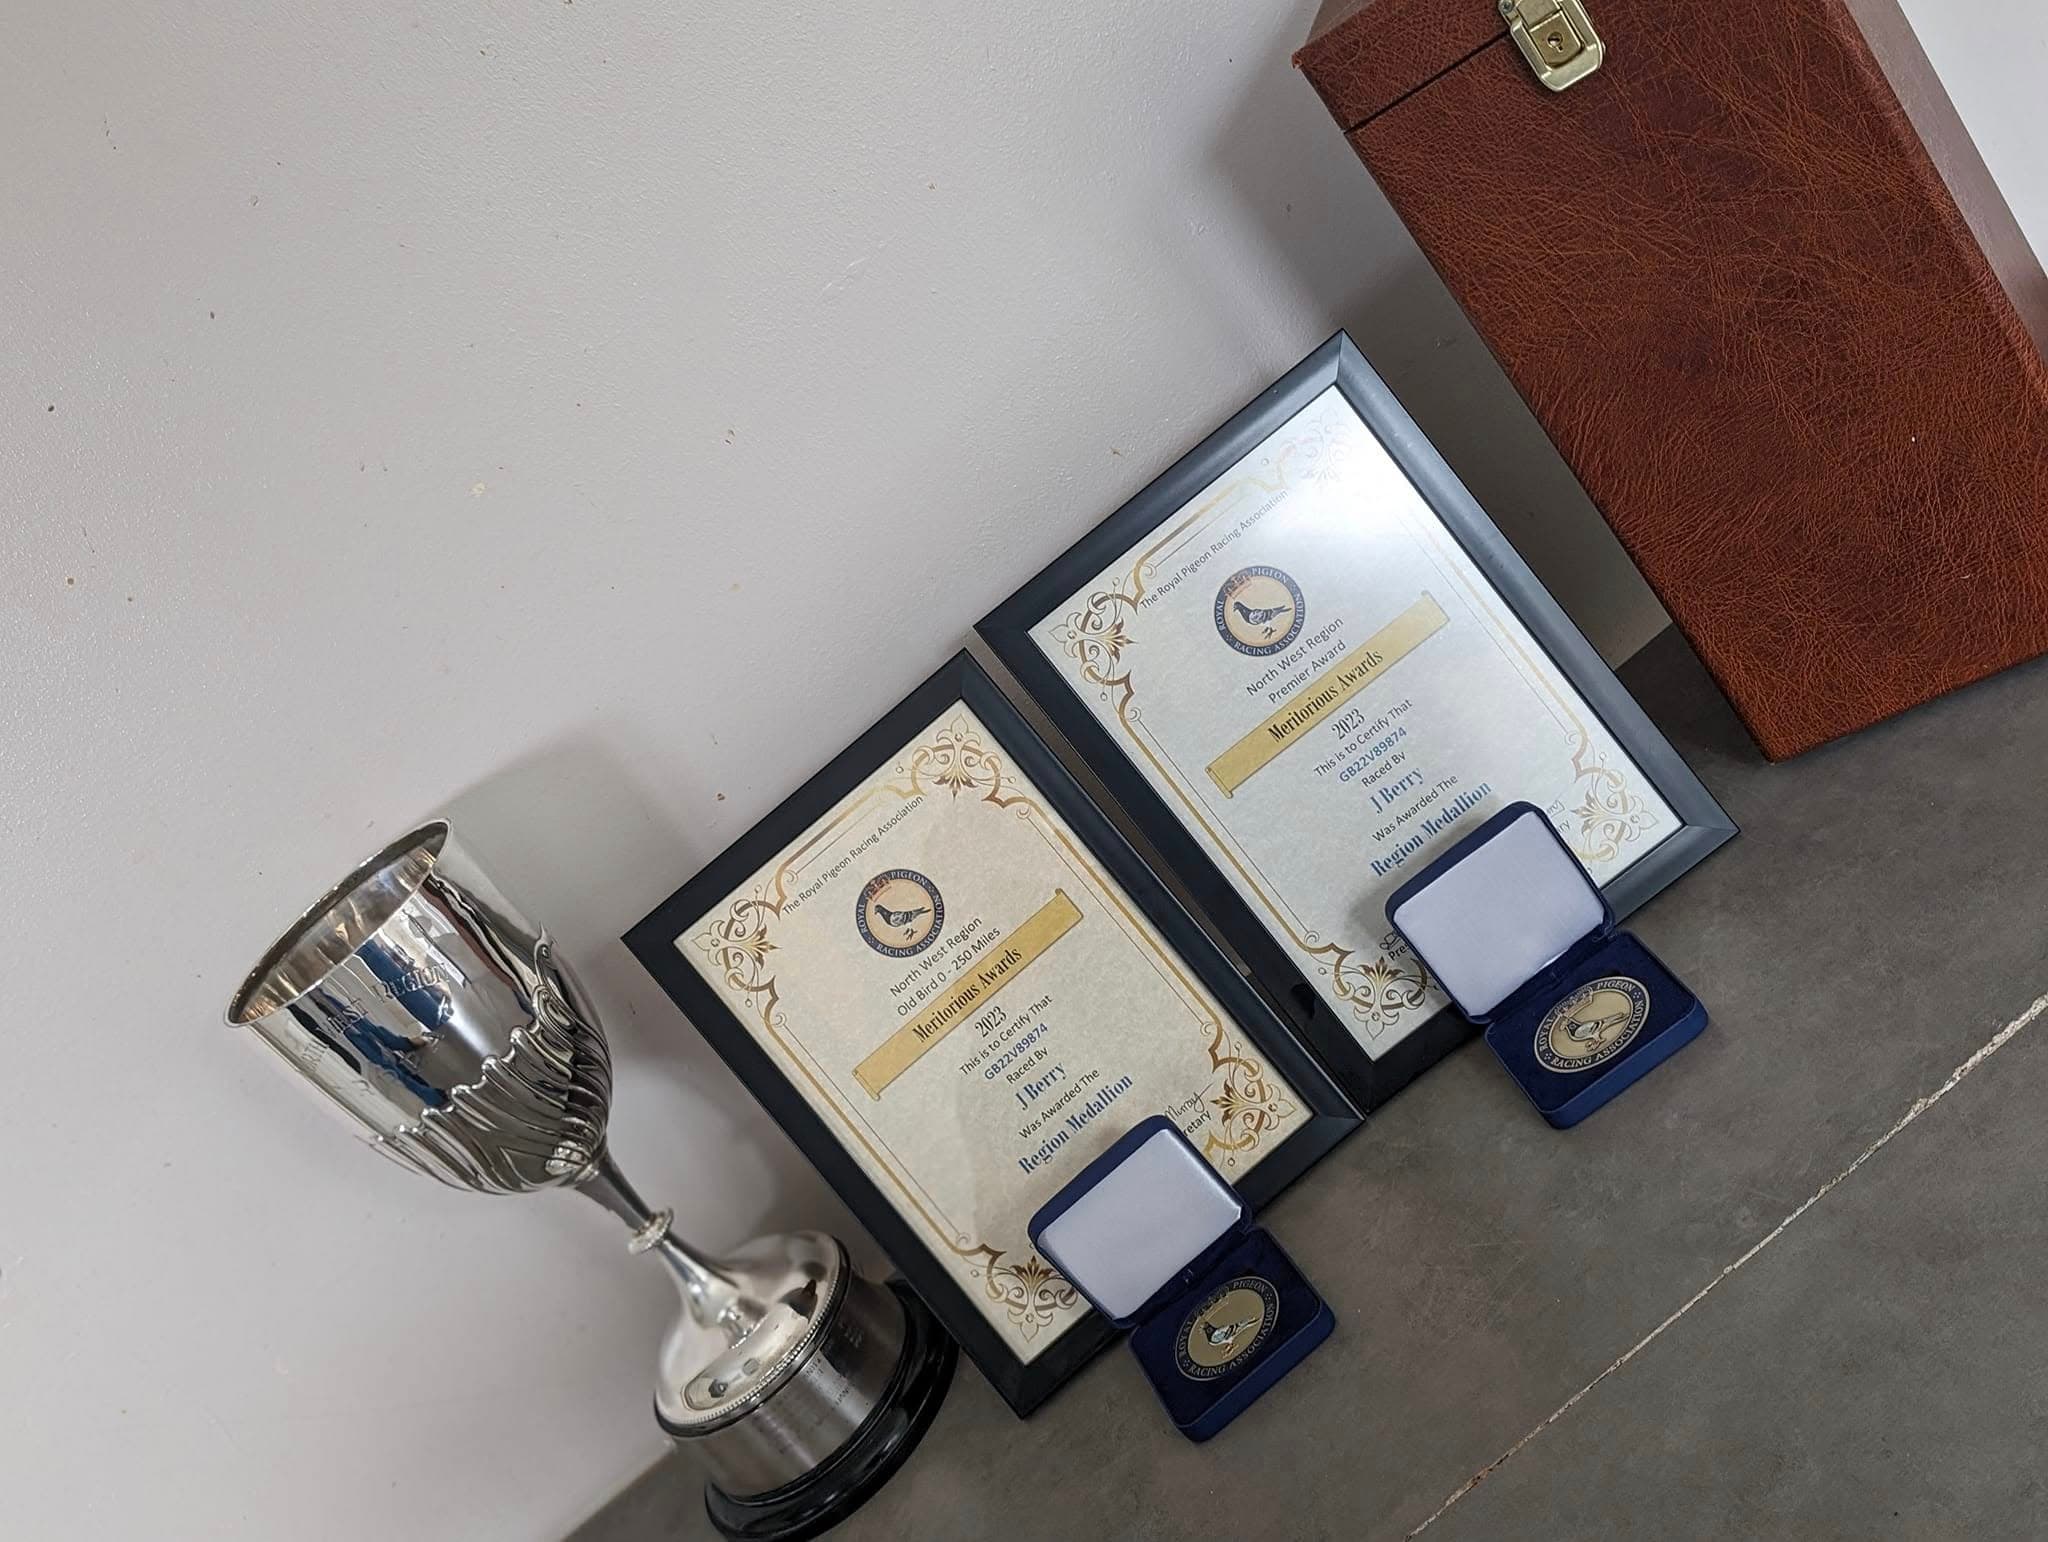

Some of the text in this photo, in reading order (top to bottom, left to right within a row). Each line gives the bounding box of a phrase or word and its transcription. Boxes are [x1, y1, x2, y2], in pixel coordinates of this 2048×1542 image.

[1140, 490, 1288, 608] The Royal Pigeon Racing Association
[1216, 568, 1288, 630] ROYAL PIGEON
[1234, 594, 1304, 655] RACING ASSOCIATION
[1246, 618, 1344, 696] North West Region
[1268, 640, 1346, 704] Premier Award
[1268, 650, 1383, 742] Meritorious Awards
[1332, 708, 1365, 740] 2023
[1314, 699, 1412, 776] This is to Certify That
[1340, 726, 1407, 782] GB22V89874
[1362, 751, 1406, 788] Raced By
[1370, 768, 1424, 814] J Berry
[1372, 775, 1458, 842] Was Awarded The
[782, 795, 924, 915] The Royal Pigeon Racing Association
[1370, 783, 1492, 876] Region Medallion
[857, 871, 928, 933] ROYAL PIGEON
[876, 895, 943, 956] RACING ASSOCIATION
[890, 917, 982, 997] North West Region
[898, 997, 918, 1016] Old
[916, 981, 938, 1004] Bird
[937, 972, 946, 982] 0
[952, 952, 972, 970] 250
[970, 926, 1000, 954] Miles
[912, 947, 1022, 1043] Meritorious Awards
[975, 1006, 1006, 1038] 2023
[1538, 980, 1636, 1052] ROYAL PIGEON
[960, 994, 1053, 1076] This is to Certify That
[984, 1023, 1048, 1080] GB22V89874
[1006, 1048, 1048, 1084] Raced By
[1550, 1000, 1644, 1068] RACING ASSOCIATION
[1016, 1062, 1067, 1111] J Berry
[1019, 1069, 1100, 1139] Was Awarded The
[1019, 1076, 1132, 1174] Region Medallion
[1184, 1110, 1211, 1136] retary
[1232, 1280, 1269, 1293] PIGEON
[1188, 1303, 1276, 1377] RACING ASSOCIATION
